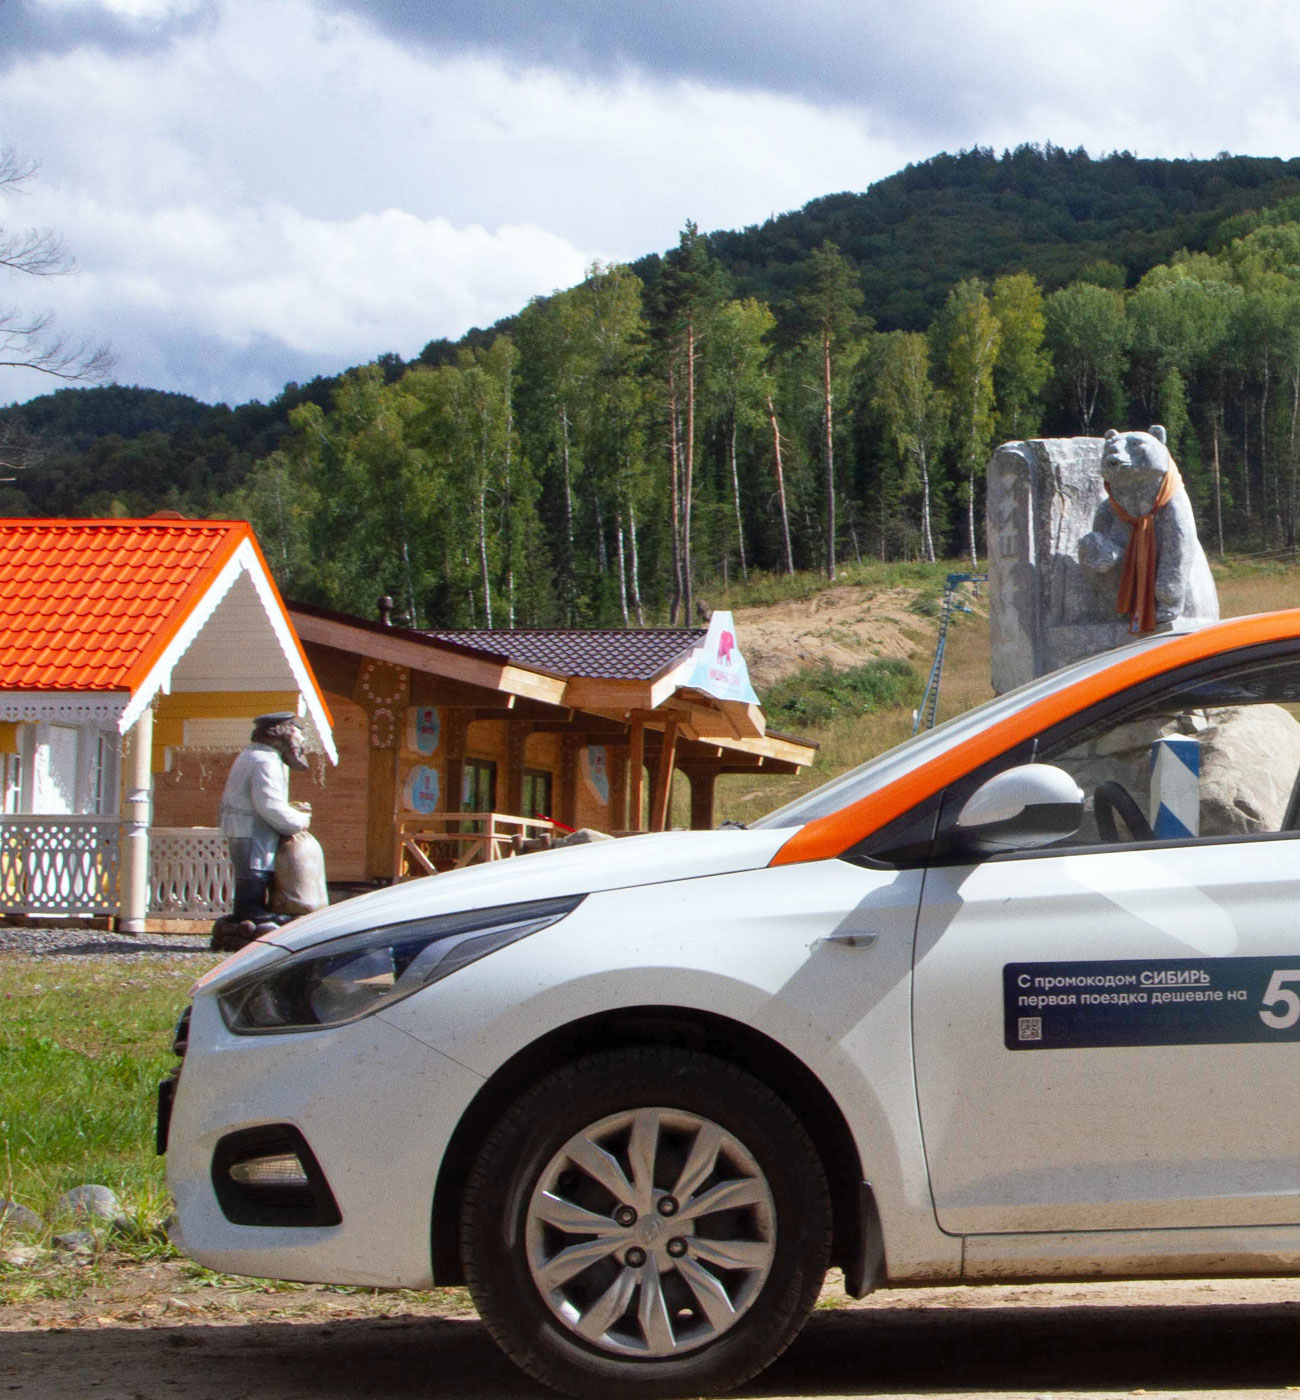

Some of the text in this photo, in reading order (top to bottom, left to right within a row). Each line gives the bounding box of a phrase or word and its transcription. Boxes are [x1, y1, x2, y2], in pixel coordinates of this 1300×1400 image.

[1018, 970, 1210, 990] С промокодом СИБИРЬ
[1018, 990, 1247, 1009] первая поездка дешевле на
